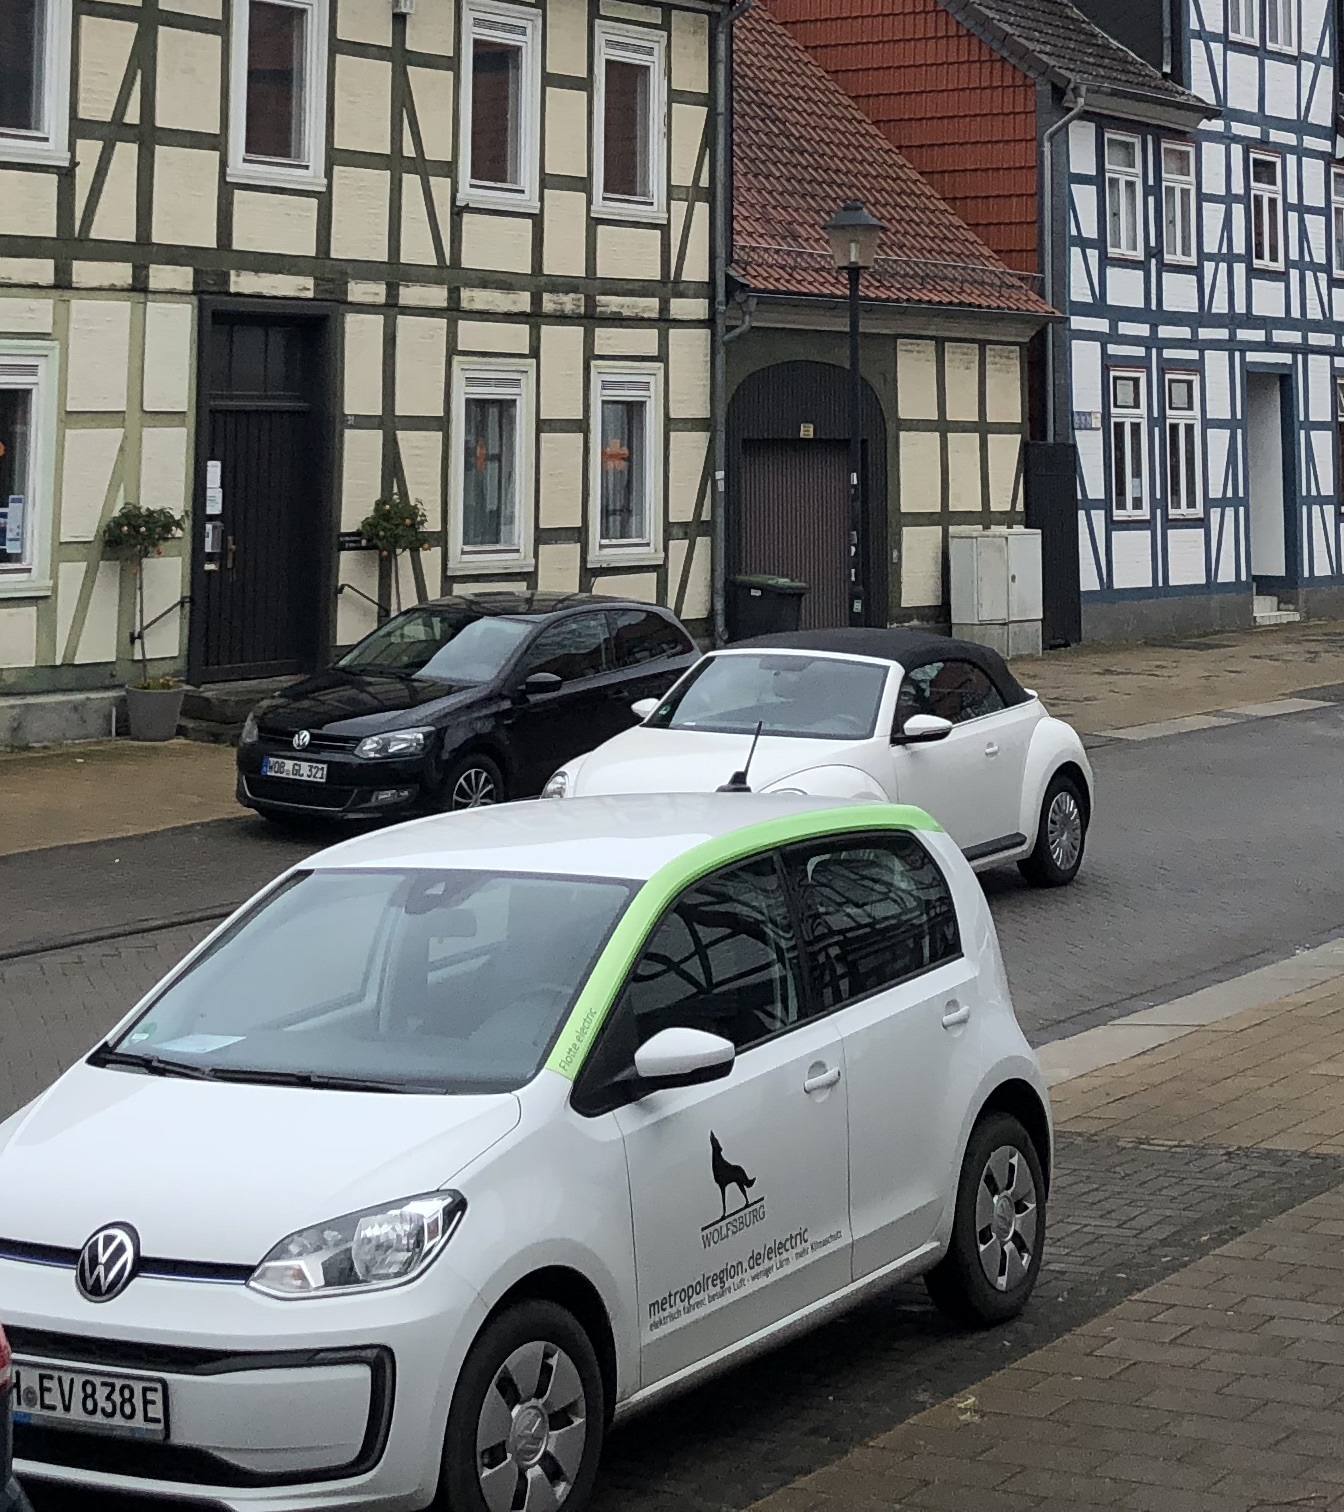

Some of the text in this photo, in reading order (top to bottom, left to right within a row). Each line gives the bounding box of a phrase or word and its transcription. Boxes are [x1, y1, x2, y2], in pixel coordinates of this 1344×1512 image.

[307, 764, 324, 780] 321
[558, 1007, 597, 1072] Flotte electric
[701, 1204, 766, 1249] WOLFSBURG
[648, 1226, 809, 1320] metropolregion.de/electric
